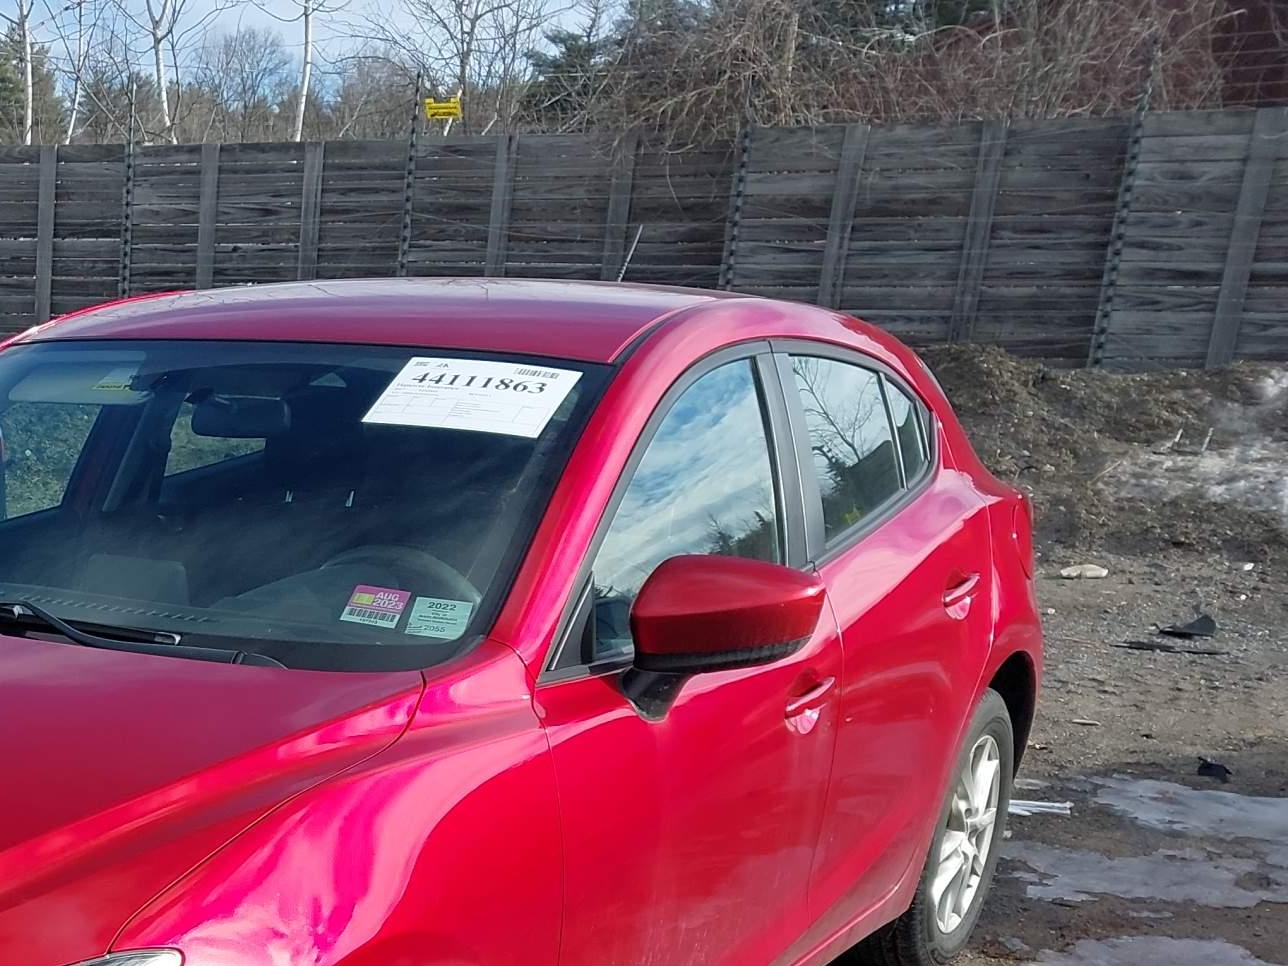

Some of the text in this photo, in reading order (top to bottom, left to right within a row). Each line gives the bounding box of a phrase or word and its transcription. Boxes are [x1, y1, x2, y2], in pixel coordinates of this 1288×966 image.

[412, 371, 548, 395] 44111863
[375, 591, 400, 601] AUG
[372, 599, 404, 610] 2023
[427, 601, 457, 611] 2022
